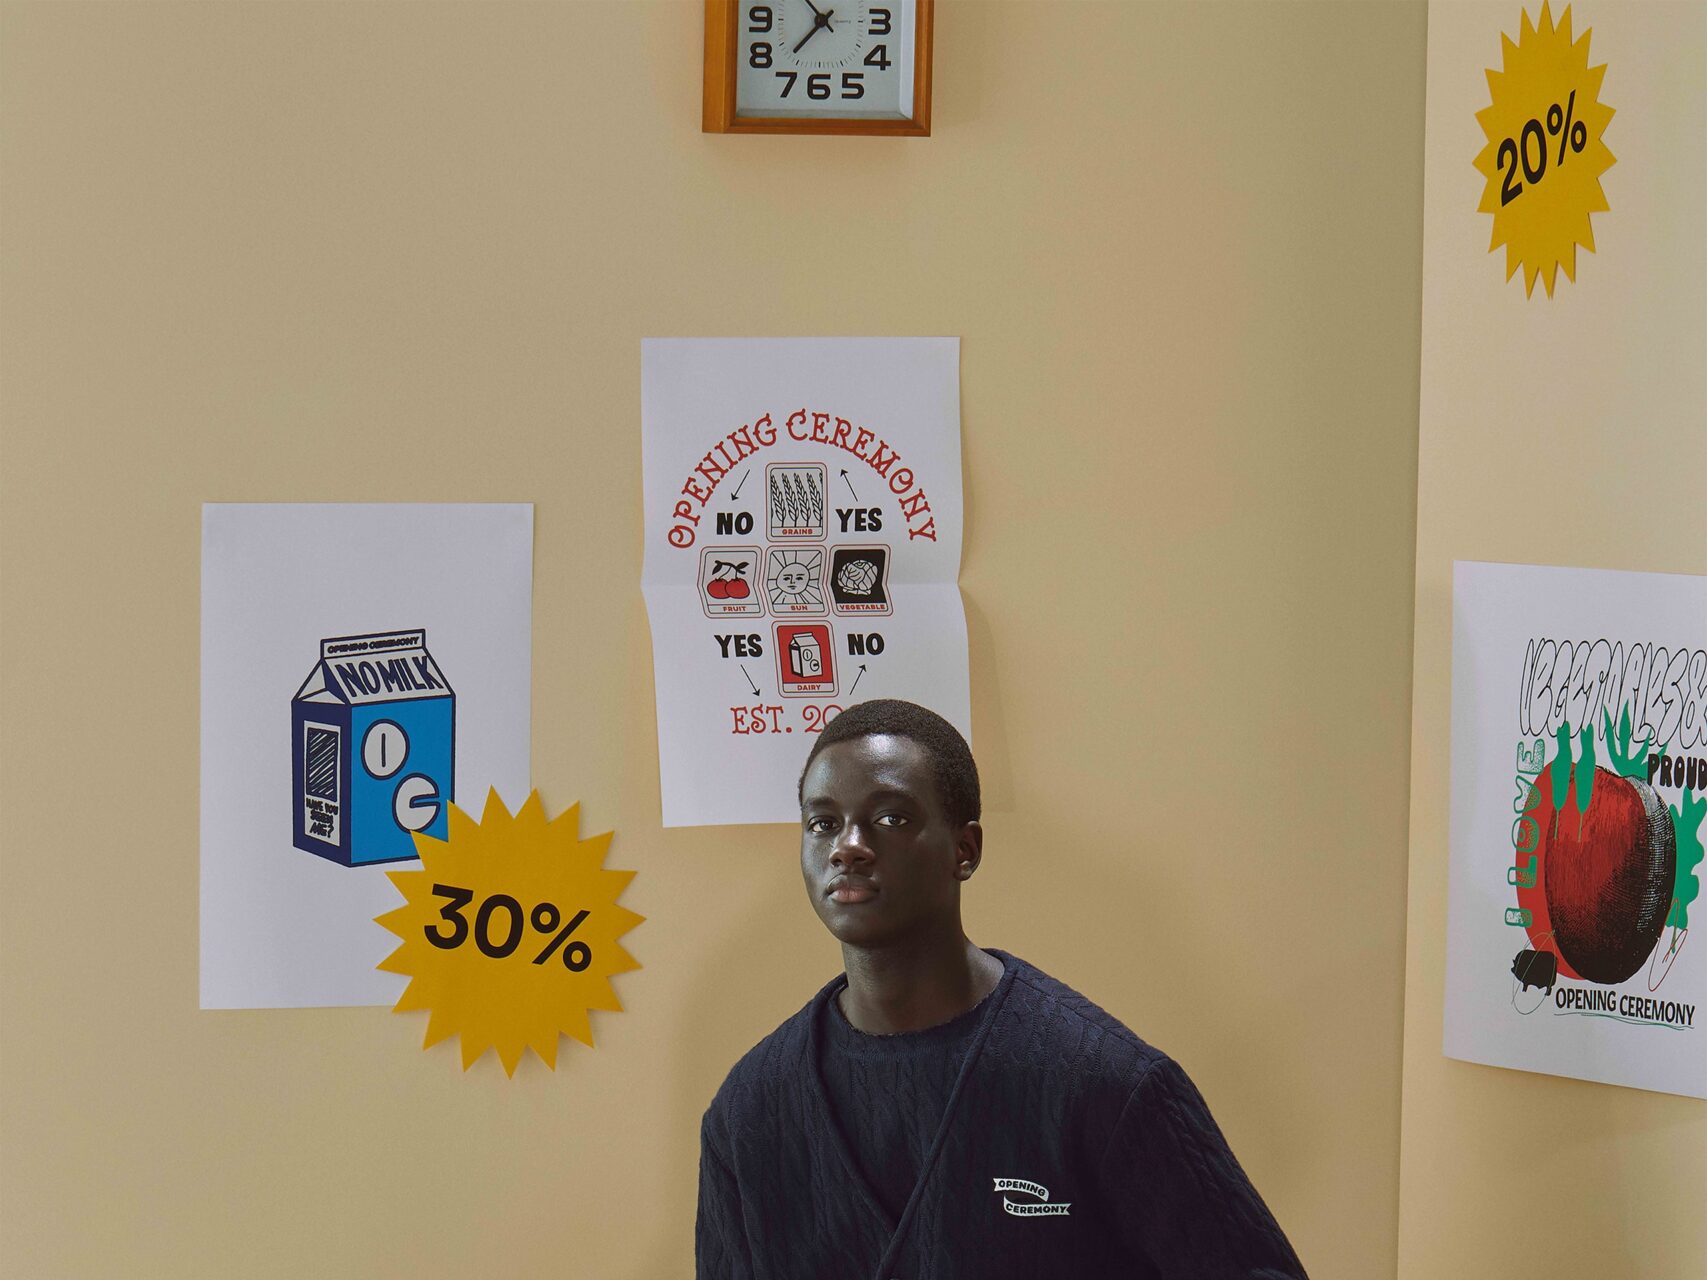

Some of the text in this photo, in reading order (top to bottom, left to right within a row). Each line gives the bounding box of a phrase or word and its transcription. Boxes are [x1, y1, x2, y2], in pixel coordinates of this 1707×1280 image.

[749, 6, 773, 33] 9
[868, 8, 892, 35] 3
[749, 42, 773, 69] 8
[863, 44, 892, 71] 4
[775, 72, 865, 100] 7 6 5
[1497, 89, 1587, 207] 20%
[667, 408, 937, 549] OPENING CEREMONY
[716, 512, 754, 535] NO
[836, 508, 883, 533] YES
[327, 636, 419, 654] OPENING CEREMONY
[714, 634, 763, 659] YES
[847, 633, 885, 656] NO
[730, 704, 793, 735] EST.
[1647, 753, 1707, 791] PROUD
[1505, 738, 1546, 928] I LOVE
[424, 883, 592, 972] 30%
[1555, 988, 1695, 1026] OPENING CEREMONY
[998, 1180, 1046, 1197] OPENING
[1005, 1203, 1066, 1214] CEREMONY
